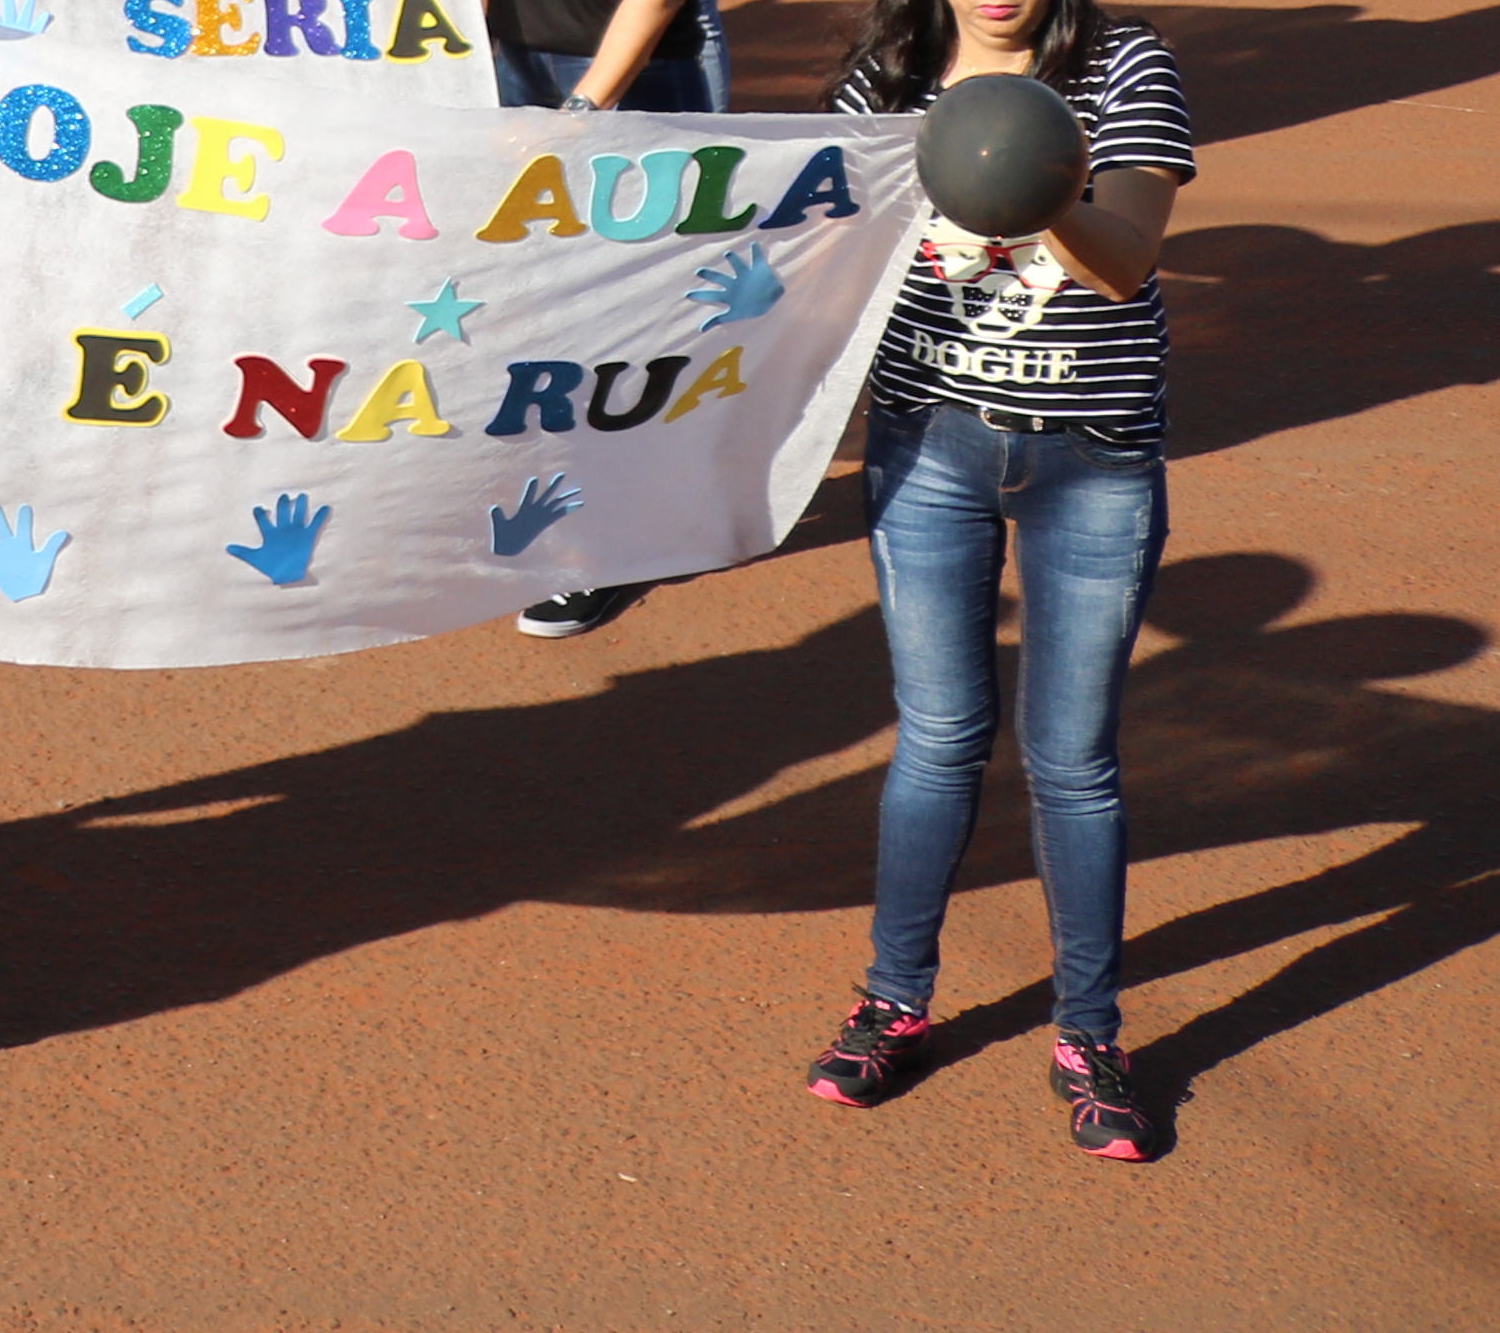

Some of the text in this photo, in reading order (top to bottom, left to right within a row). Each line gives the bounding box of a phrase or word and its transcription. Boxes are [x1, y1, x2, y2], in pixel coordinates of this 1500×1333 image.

[321, 145, 860, 244] A AULA
[221, 351, 451, 444] NA
[485, 344, 746, 438] RUA
